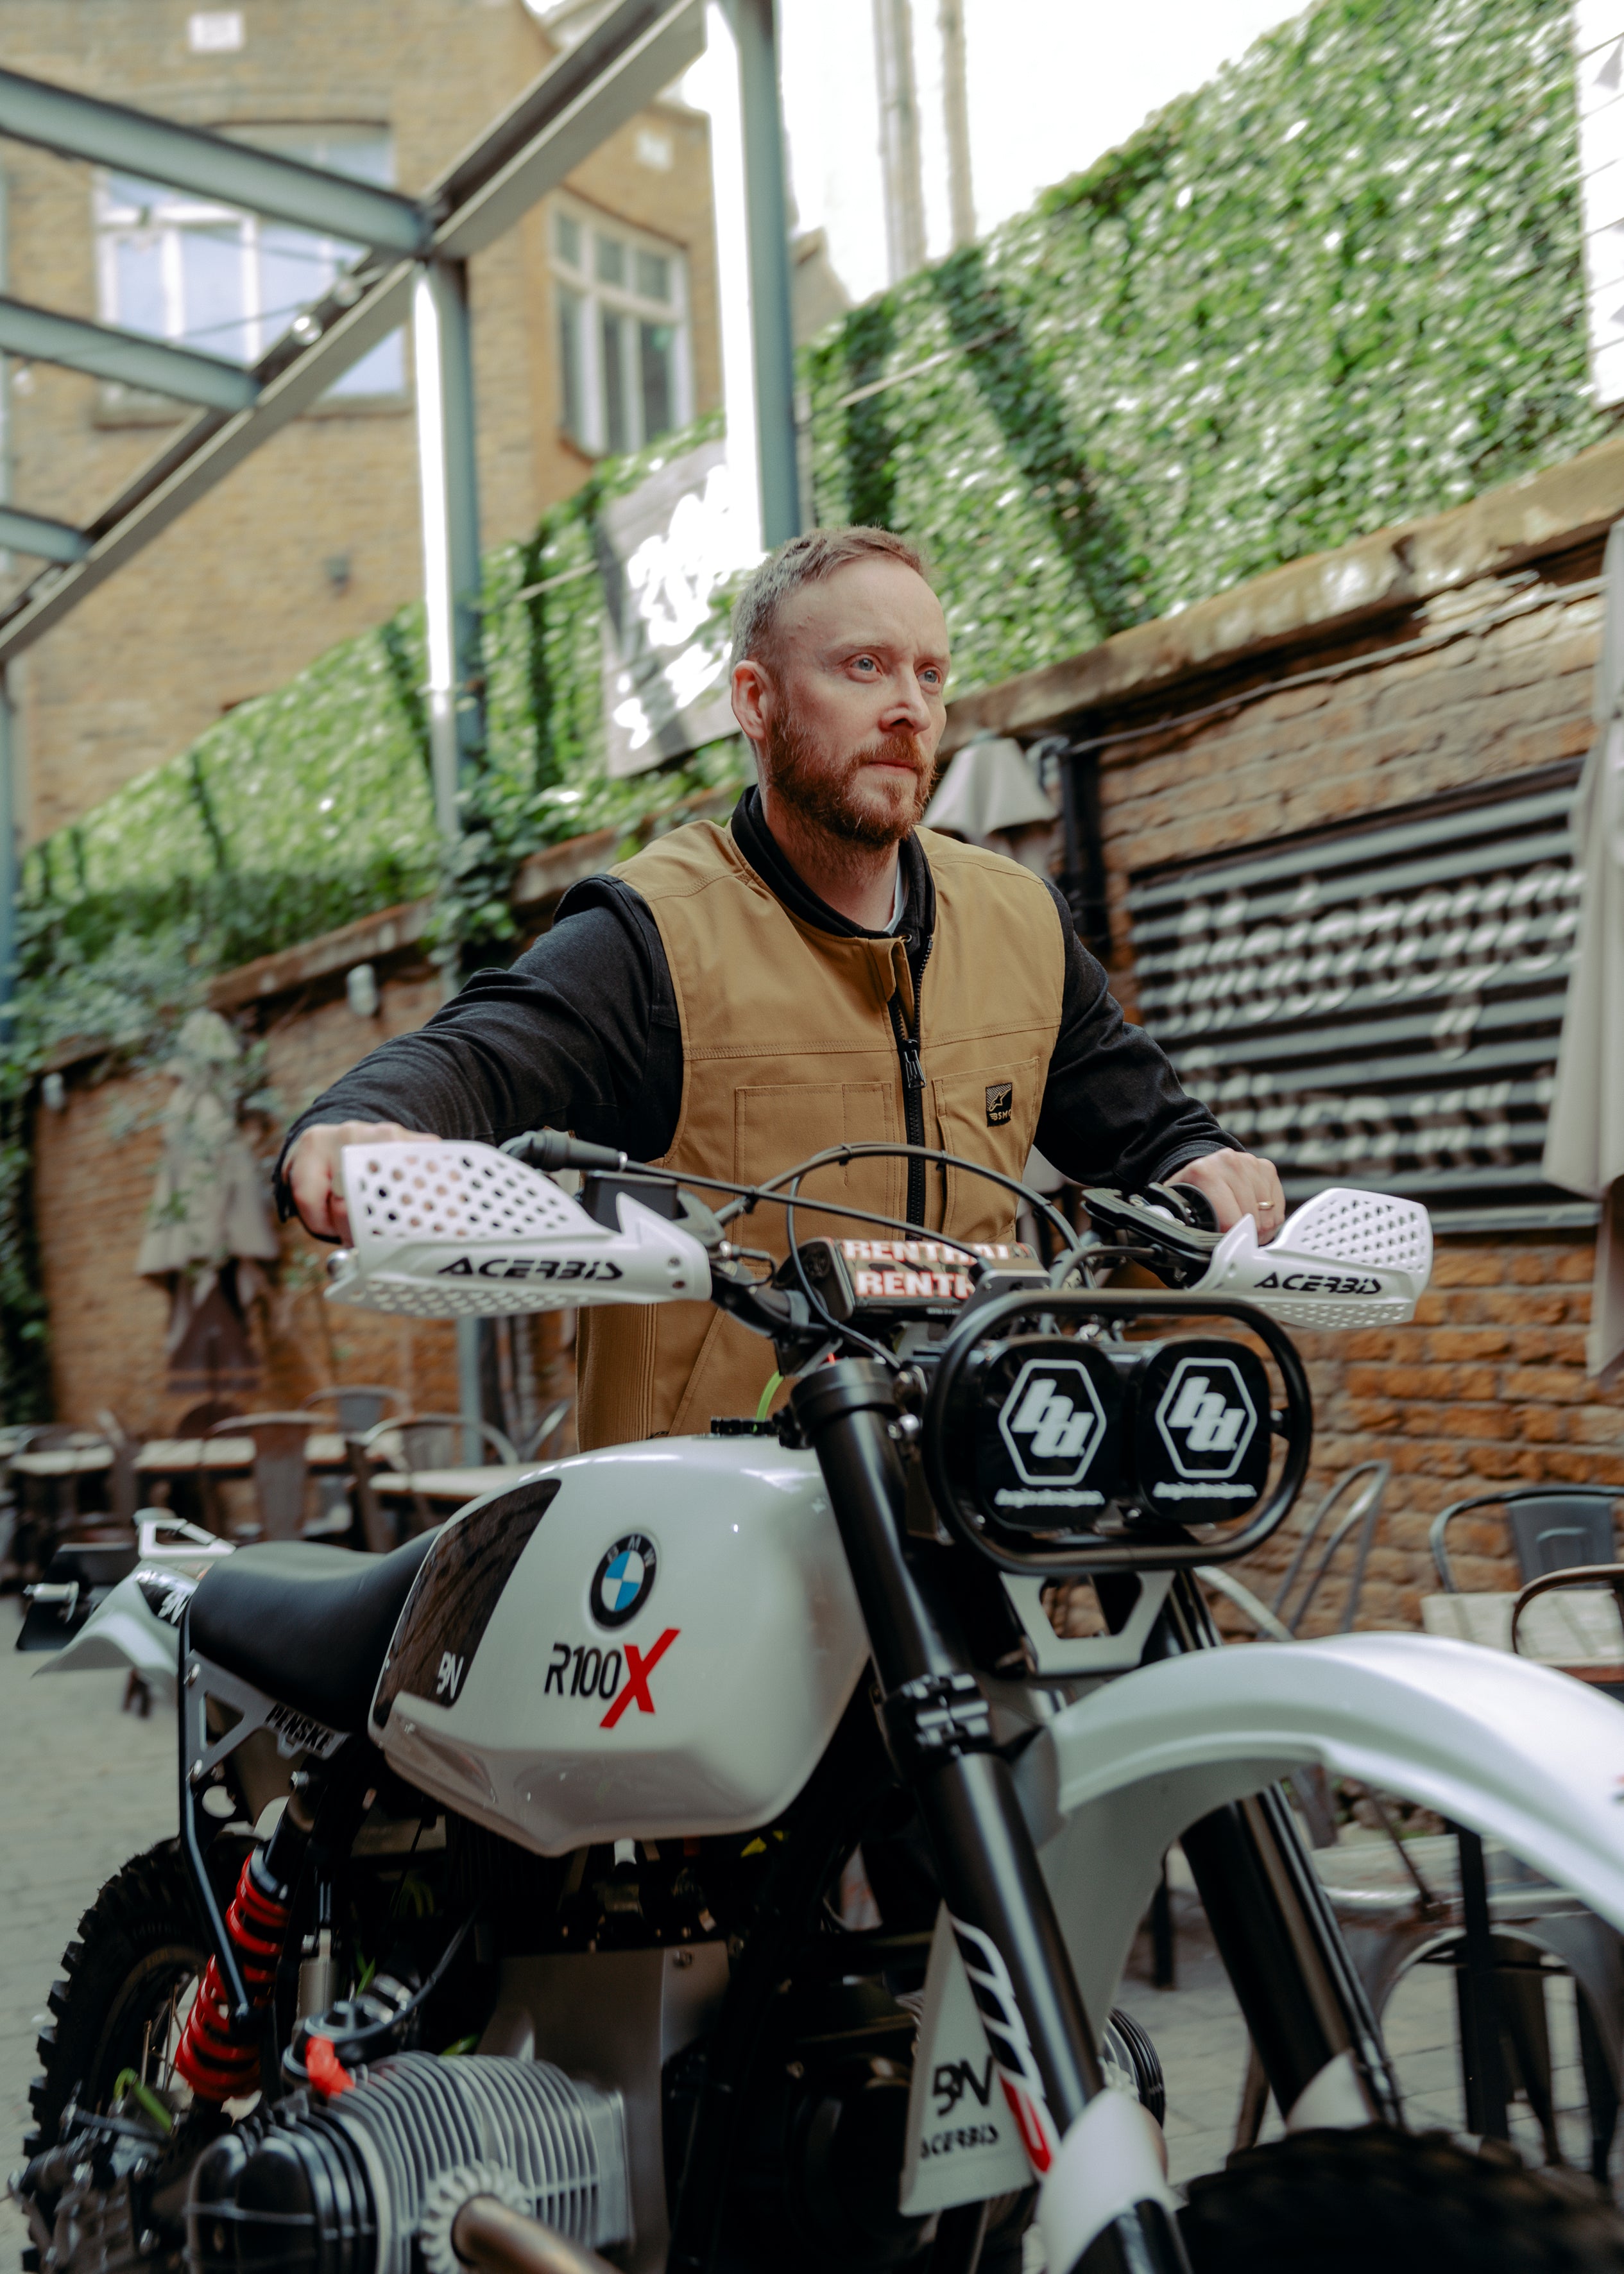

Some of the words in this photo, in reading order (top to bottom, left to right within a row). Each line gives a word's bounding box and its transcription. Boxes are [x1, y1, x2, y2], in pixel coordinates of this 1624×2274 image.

[437, 1256, 624, 1280] ACERBIS
[855, 1270, 976, 1299] RENTH
[1253, 1271, 1383, 1295] ACERBIS
